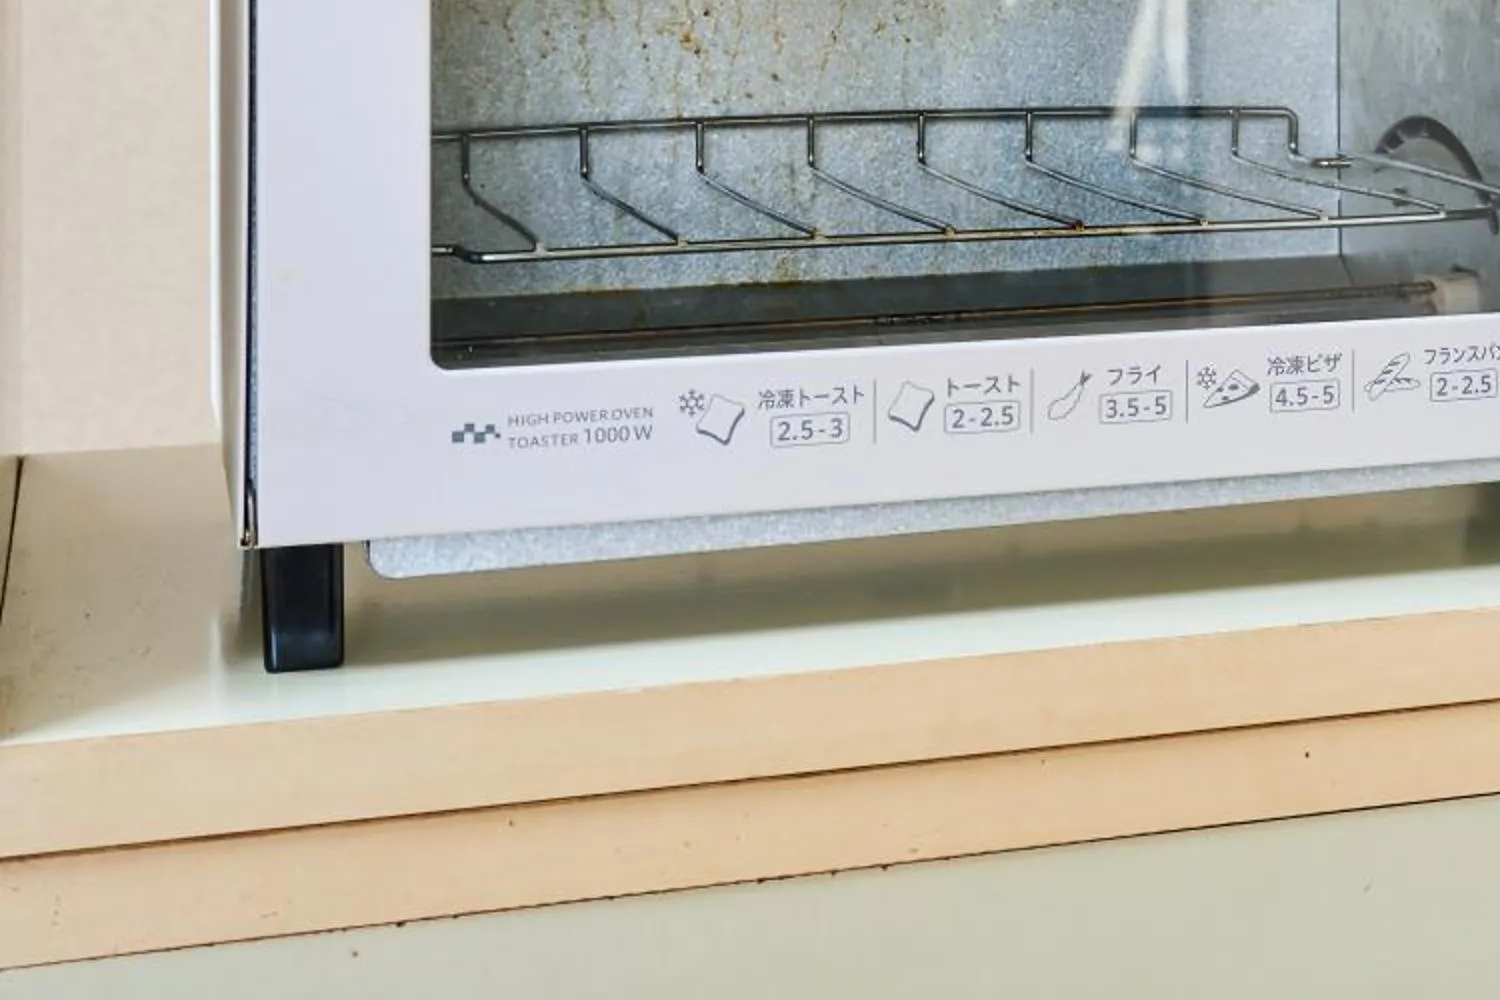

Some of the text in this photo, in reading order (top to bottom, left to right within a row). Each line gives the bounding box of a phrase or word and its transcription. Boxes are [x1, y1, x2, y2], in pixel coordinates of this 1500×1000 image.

[1107, 364, 1162, 386] フライ
[1266, 352, 1343, 377] 冷凍ピザ
[758, 384, 865, 410] 冷凍トースト
[946, 374, 1022, 397] トースト
[1275, 385, 1336, 407] 4.5-5
[1436, 374, 1492, 397] 2-2.5
[507, 407, 654, 428] HIGH POWER OVEN
[951, 405, 1014, 429] 2-2.5
[1105, 394, 1168, 419] 3.5-5
[507, 424, 654, 450] TOASTER 1000 W
[777, 417, 844, 441] 2.5-3
